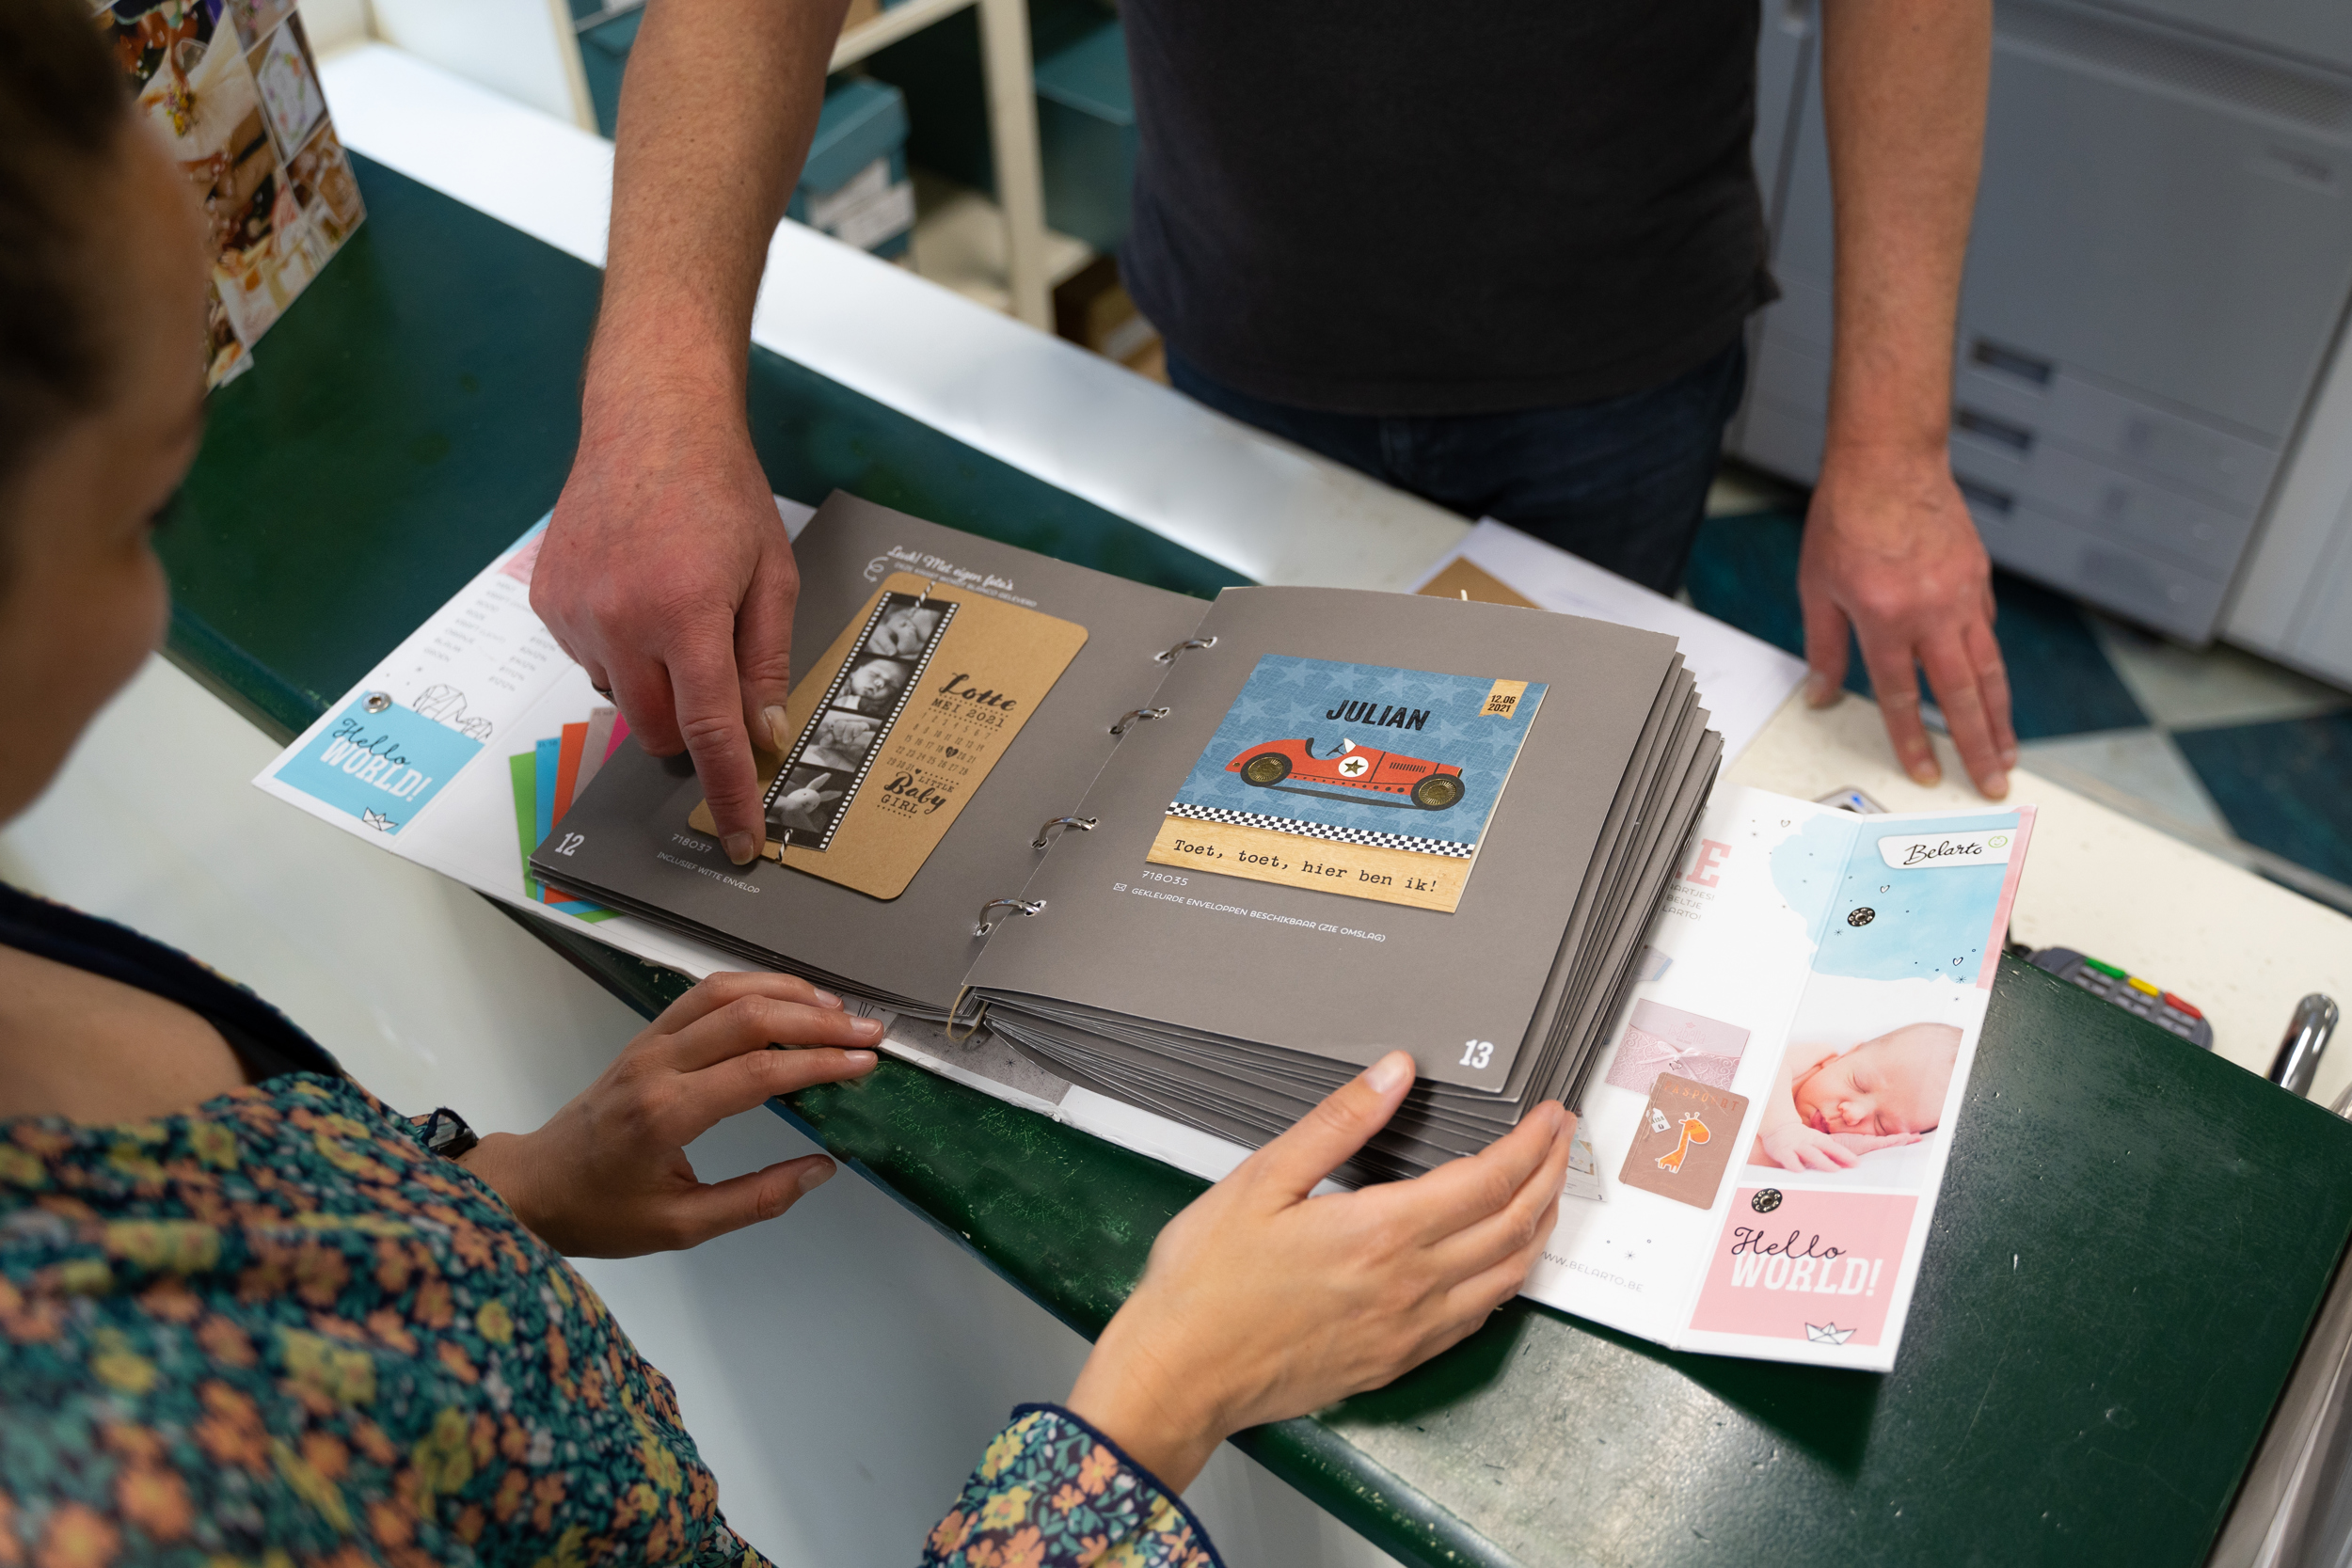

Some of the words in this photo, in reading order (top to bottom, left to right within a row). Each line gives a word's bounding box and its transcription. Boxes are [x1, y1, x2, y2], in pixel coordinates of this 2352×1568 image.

[939, 673, 1017, 711] Lotte
[1490, 694, 1517, 705] 12.06
[931, 698, 961, 713] MEI
[966, 709, 1004, 728] 2021
[1326, 699, 1431, 732] JULIAN
[1486, 703, 1511, 713] 2021
[931, 715, 938, 723] 2
[942, 719, 948, 727] 3
[953, 721, 960, 730] 4
[332, 718, 411, 766] Hello
[923, 726, 930, 735] 9
[933, 730, 942, 738] 10
[954, 736, 963, 745] 12
[965, 740, 975, 749] 13
[976, 744, 985, 752] 14
[925, 741, 934, 750] 17
[935, 745, 944, 753] 18
[956, 752, 967, 761] 20
[320, 736, 433, 802] WORLD!
[886, 757, 897, 767] 29
[896, 761, 906, 769] 30
[905, 764, 914, 772] 31
[896, 746, 905, 754] 22
[905, 750, 916, 758] 23
[926, 757, 936, 766] 25
[937, 760, 948, 769] 26
[947, 764, 959, 772] 27
[959, 768, 969, 777] 28
[883, 770, 946, 816] Baby
[918, 776, 955, 793] LITTLE
[881, 794, 918, 815] GIRL
[554, 832, 585, 857] 12
[672, 833, 712, 854] 718037
[1902, 840, 1983, 865] Belarto
[657, 851, 698, 871] INCLUSIEF
[697, 866, 723, 881] WITTE
[723, 876, 760, 894] ENVELOP
[1141, 870, 1189, 887] 718035
[1172, 839, 1224, 860] Toet,
[1237, 848, 1290, 870] toet,
[1301, 860, 1348, 879] hier
[1359, 869, 1393, 886] ben
[1405, 877, 1438, 893] ik!
[1131, 887, 1184, 905] GEKLEURDE
[1185, 898, 1248, 917] ENVELOPPEN
[1249, 910, 1317, 930] BESCHIKBAAR
[1317, 923, 1339, 934] (ZIE
[1340, 927, 1387, 942] OMSLAG)
[1661, 905, 1702, 922] LARTO!
[1458, 1038, 1495, 1069] 13
[1731, 1227, 1847, 1259] Hello
[1731, 1249, 1884, 1297] WORLD!
